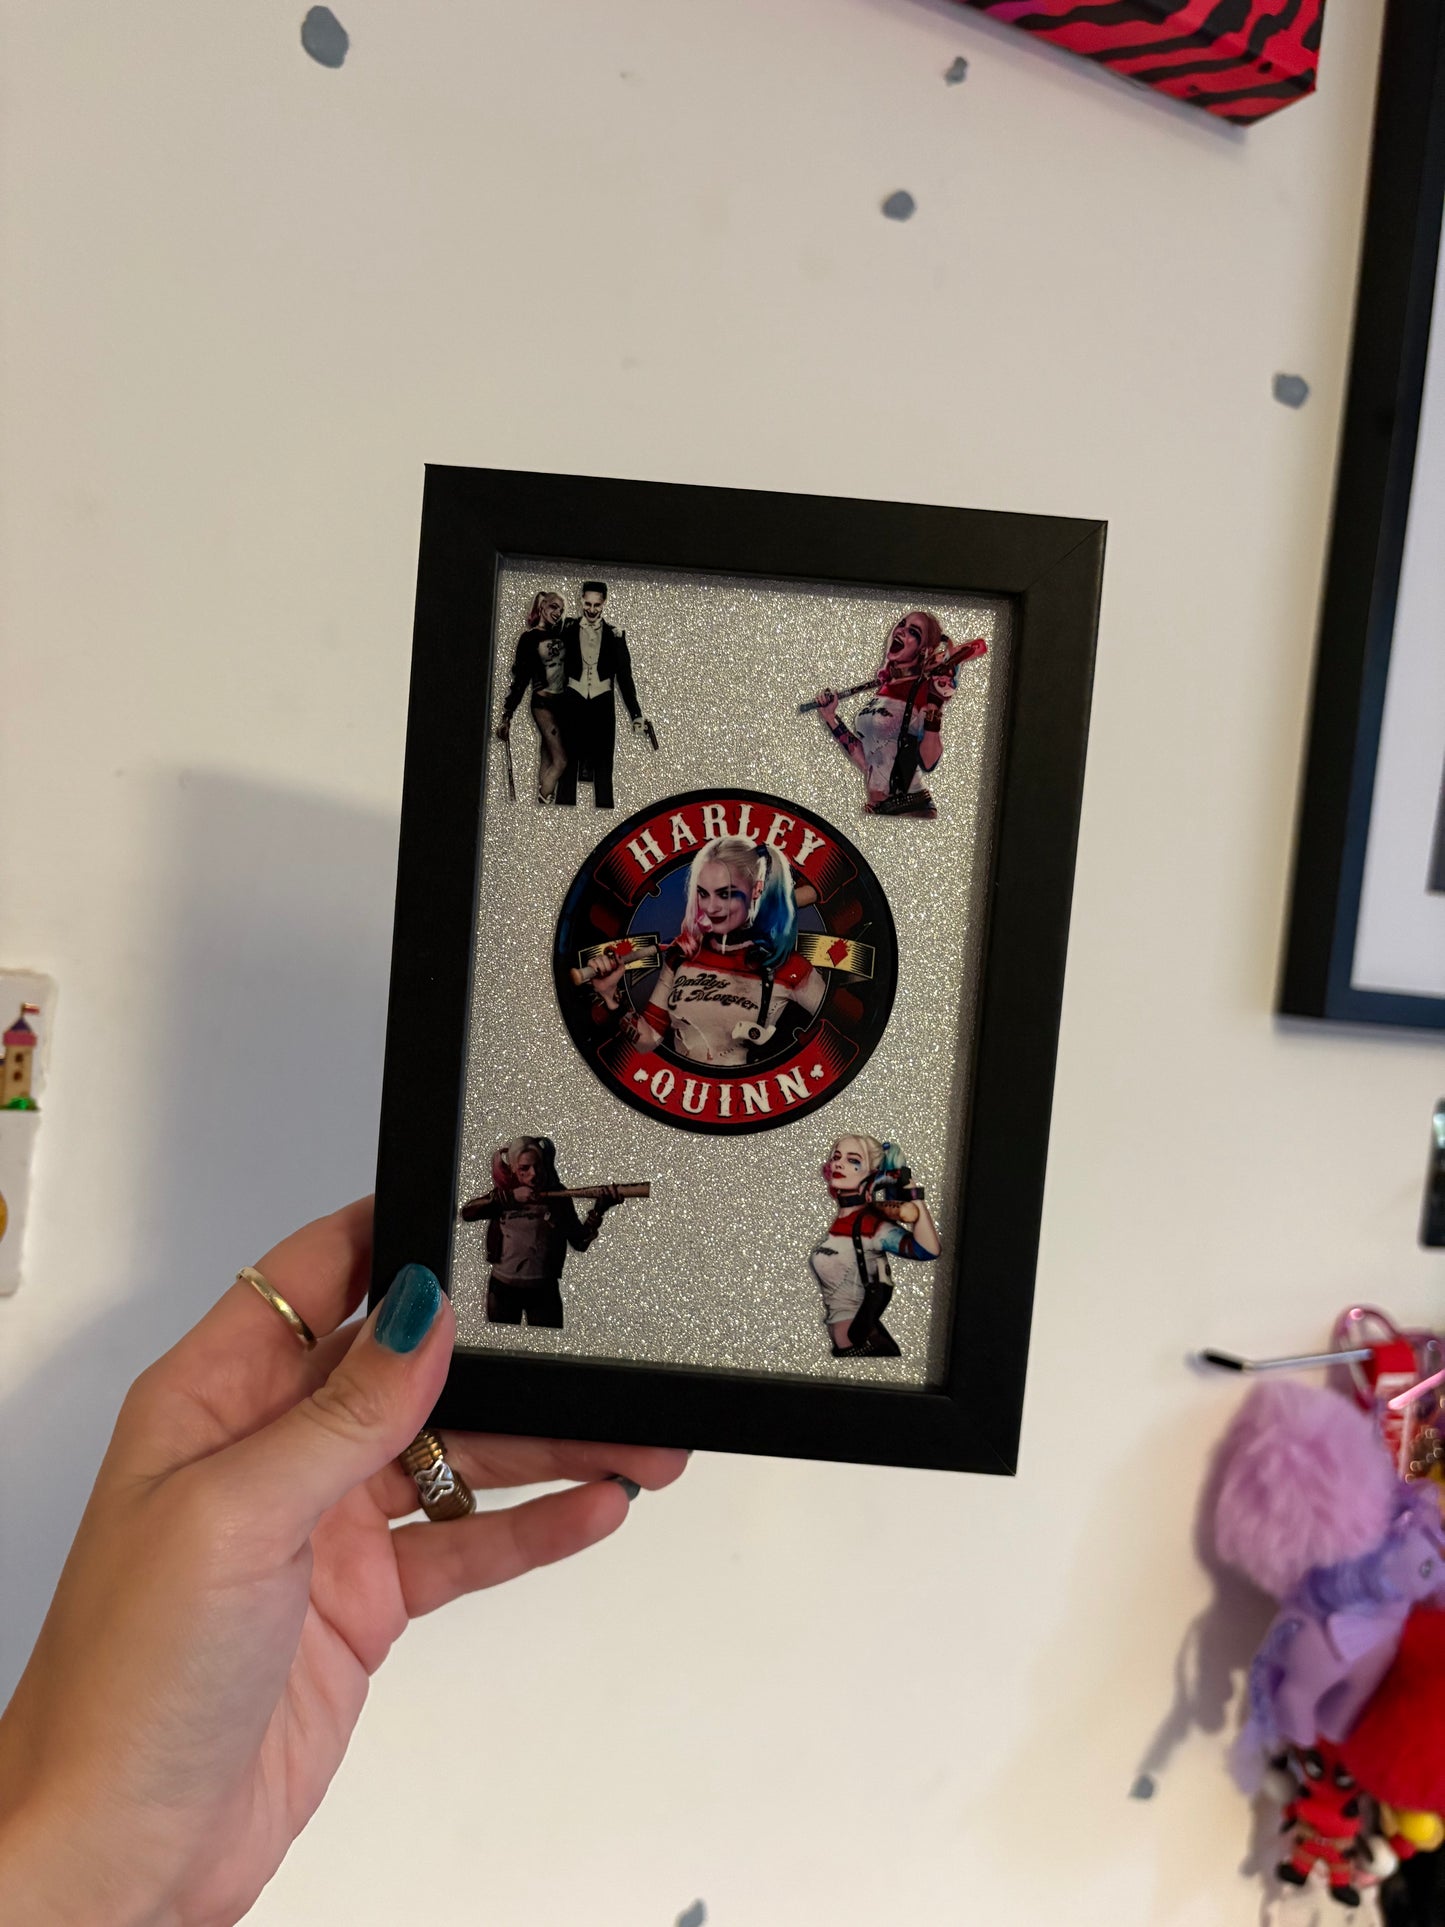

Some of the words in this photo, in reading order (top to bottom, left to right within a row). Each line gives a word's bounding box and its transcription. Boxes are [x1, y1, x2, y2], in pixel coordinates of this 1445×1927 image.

[626, 803, 826, 874] HARLEY
[684, 989, 759, 1010] Monster
[650, 1065, 812, 1118] QUINN
